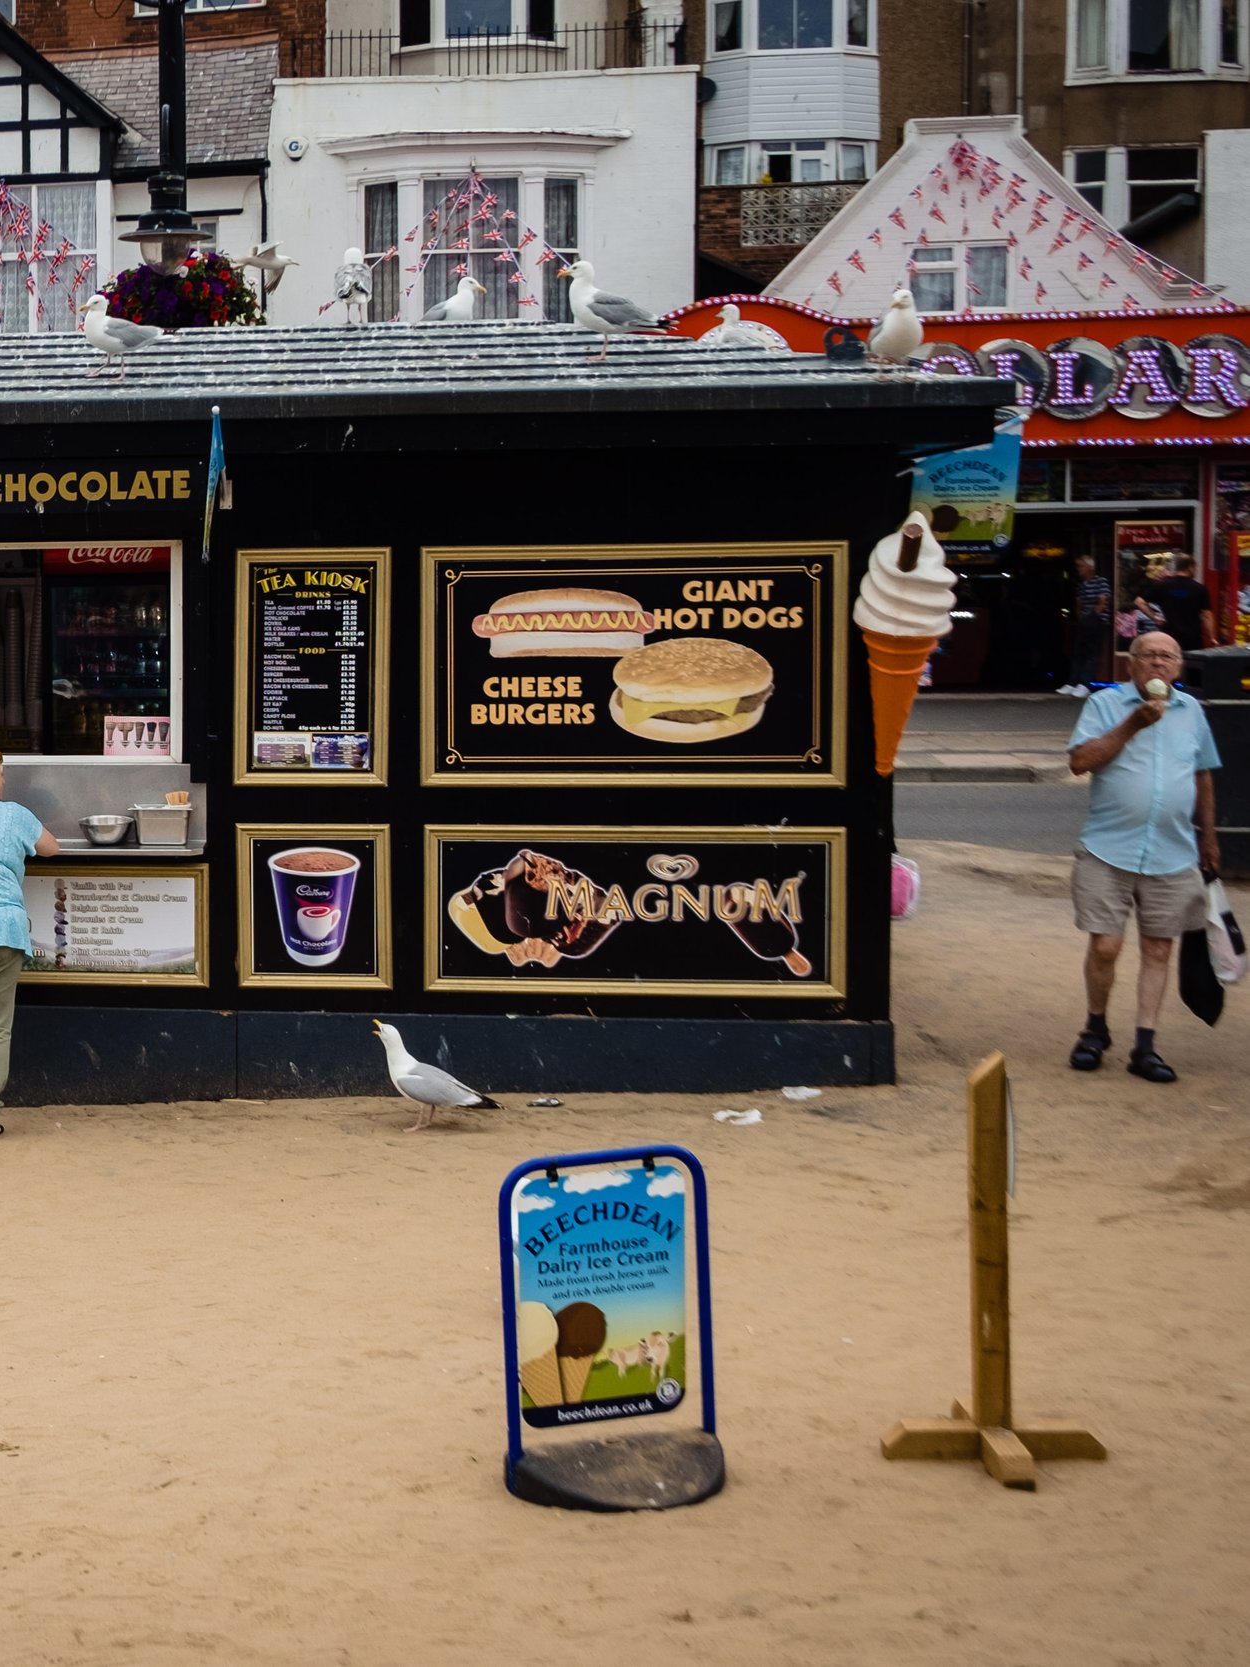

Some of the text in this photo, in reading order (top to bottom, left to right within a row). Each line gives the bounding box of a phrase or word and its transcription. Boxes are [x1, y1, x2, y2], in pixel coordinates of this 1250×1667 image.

[257, 571, 369, 594] TEA KIOSK
[682, 580, 774, 602] GIANT
[654, 606, 804, 631] HOT DOGS
[483, 676, 582, 698] CHEESE
[470, 703, 596, 725] BURGERS
[70, 882, 133, 891] Vanilla with Pod
[70, 893, 119, 902] Strawberries
[131, 893, 160, 902] Clotted
[296, 884, 330, 896] Cadbury
[70, 904, 138, 914] Belgian Chocolate
[545, 873, 806, 923] MAGNUM
[70, 916, 106, 924] Brownies
[70, 937, 113, 946] Bubblegum
[302, 938, 338, 947] Chocolate
[70, 948, 150, 958] Mint Chocolate Chip
[70, 959, 117, 968] Honeycomb
[524, 1201, 681, 1258] BEECHDEAN
[558, 1235, 650, 1257] Farmhouse
[537, 1249, 670, 1279] Dairy Ice Cream
[537, 1265, 670, 1289] Made from fresh Jersey milk
[551, 1282, 656, 1300] and rich double cream
[557, 1399, 654, 1422] beechdean.co.uk
